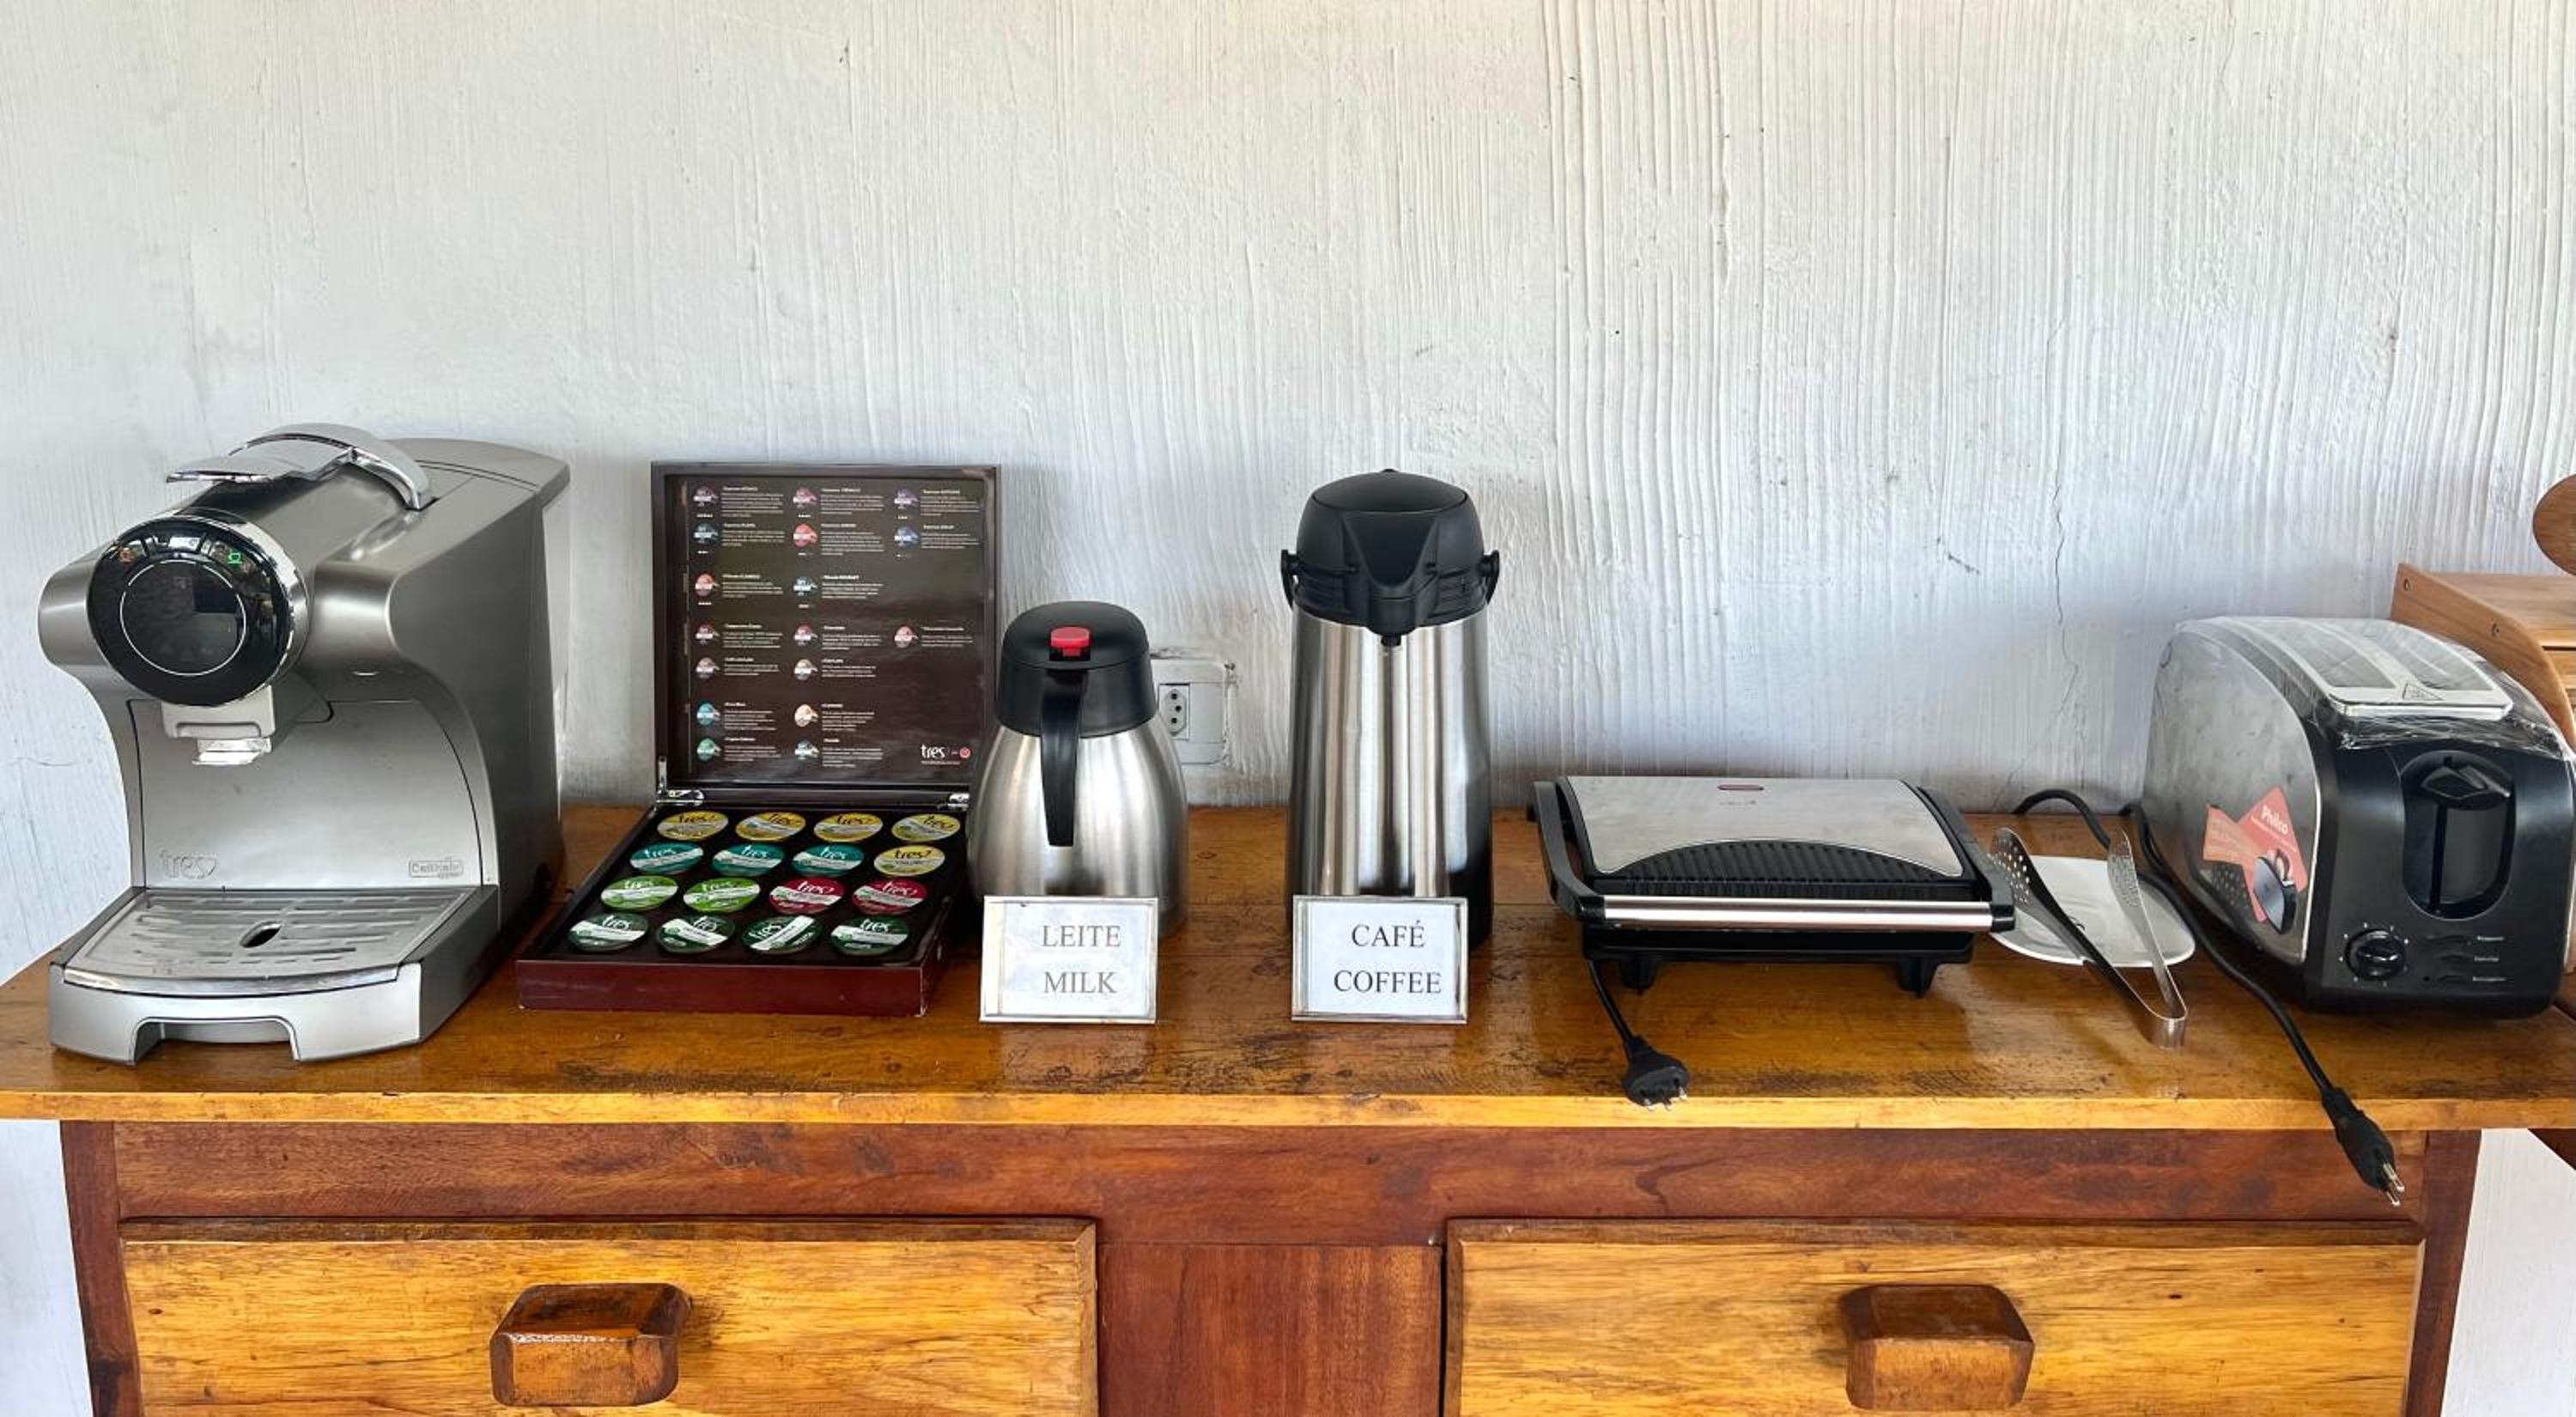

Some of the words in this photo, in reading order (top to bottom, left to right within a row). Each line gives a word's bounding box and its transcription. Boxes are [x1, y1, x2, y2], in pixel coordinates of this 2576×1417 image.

[920, 744, 945, 759] tres
[2261, 805, 2288, 836] Philco
[1042, 925, 1121, 947] LEITE
[1352, 920, 1426, 948] CAFÉ
[1043, 971, 1118, 994] MILK
[1334, 970, 1443, 994] COFFEE
